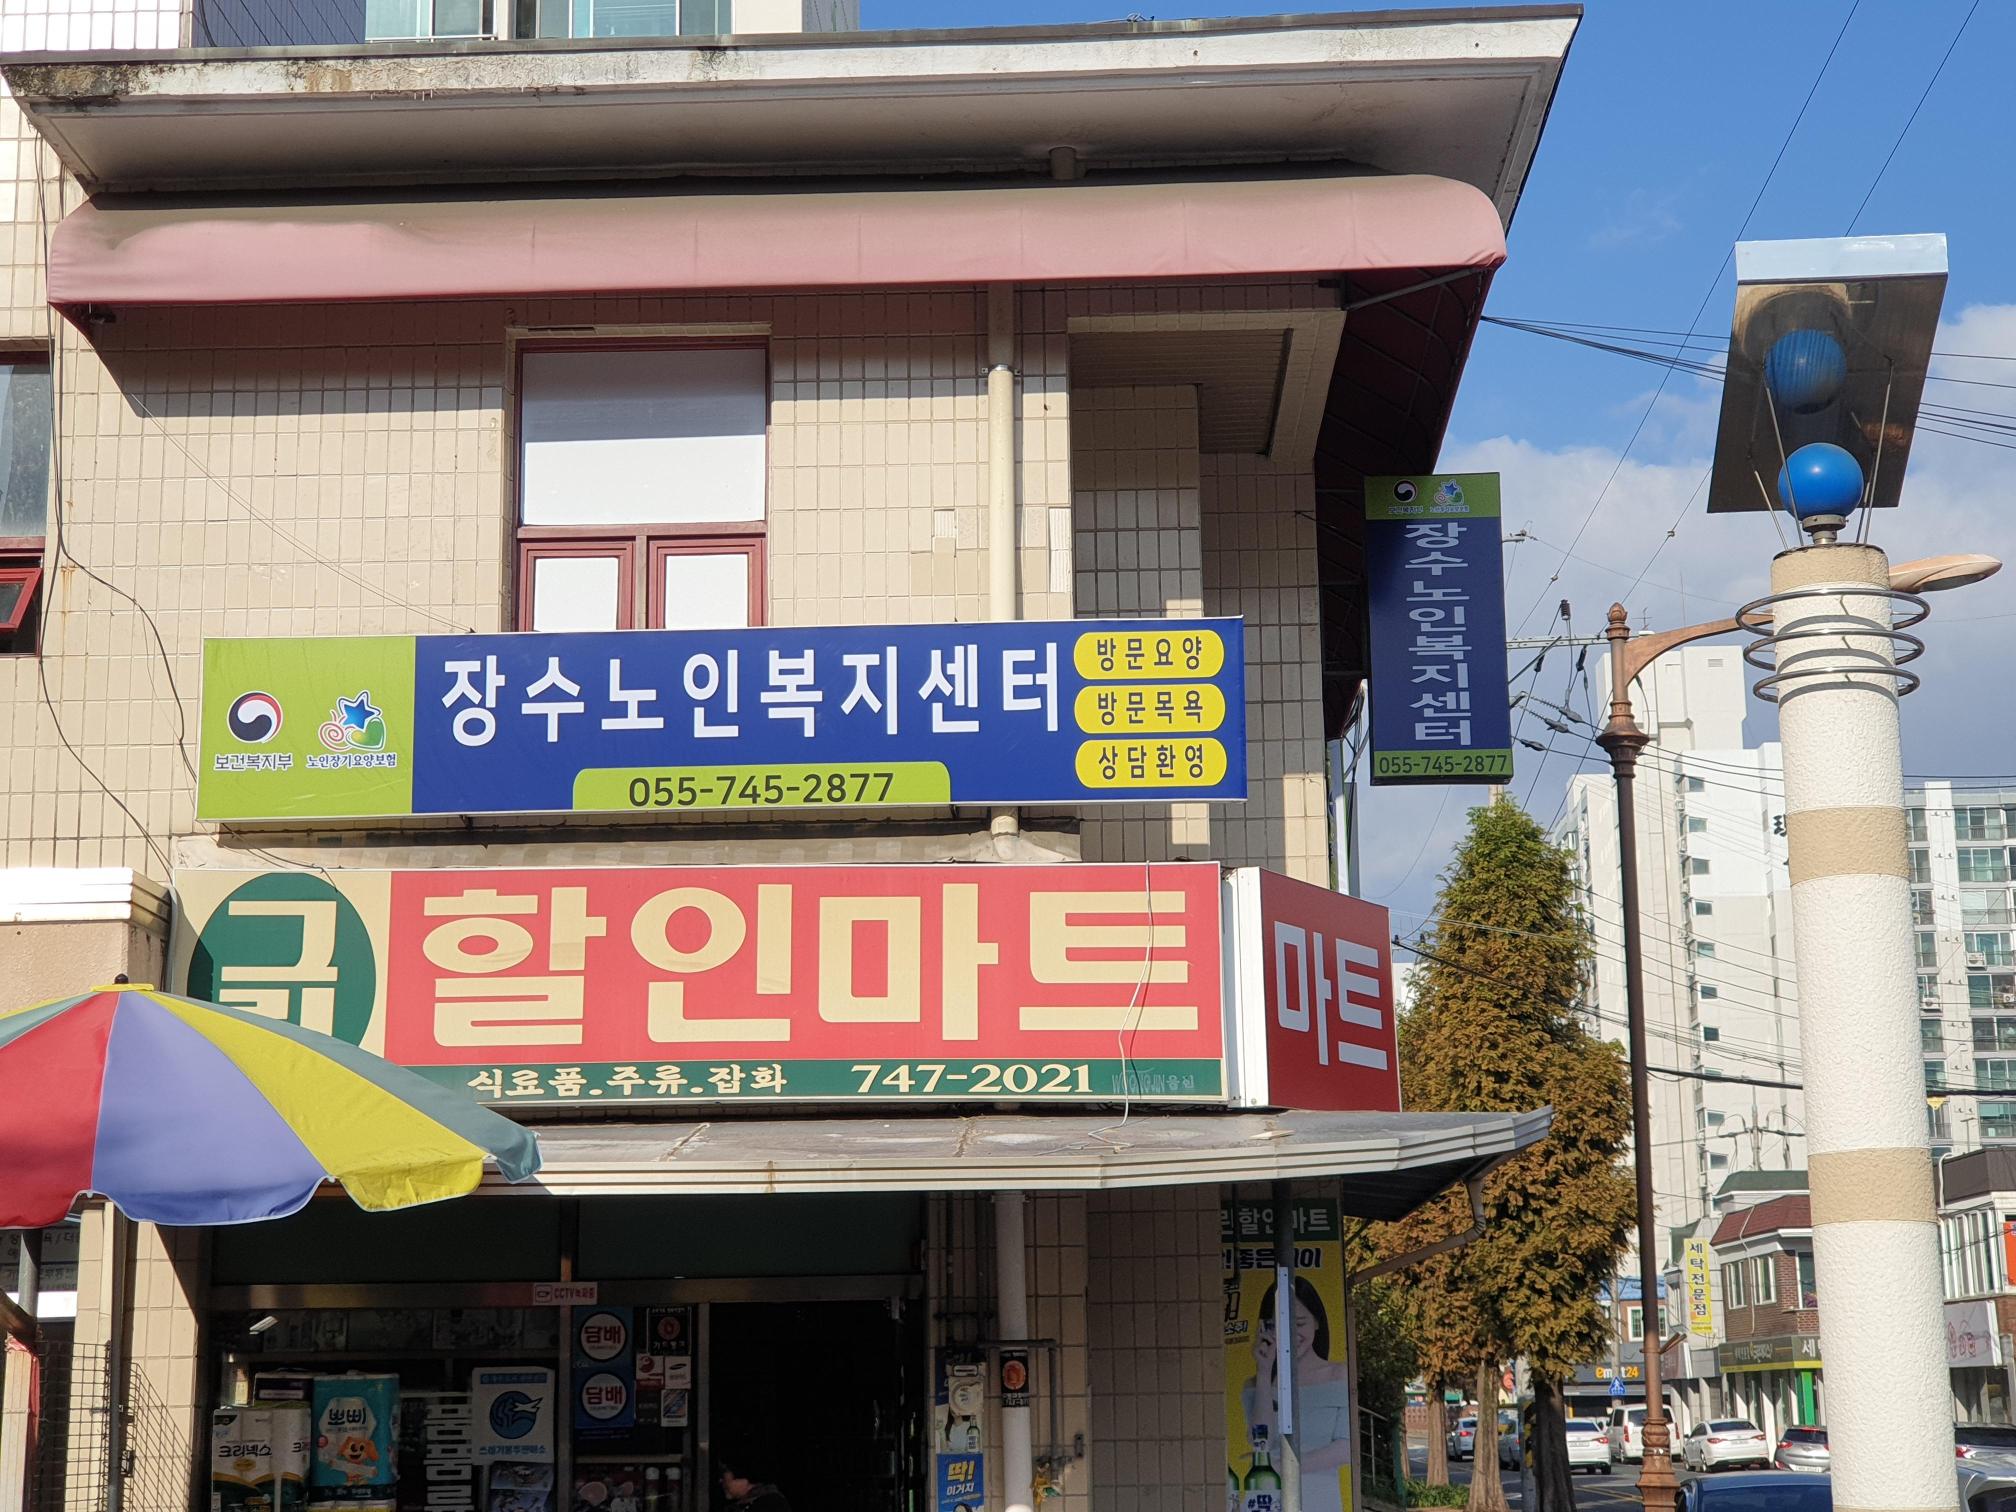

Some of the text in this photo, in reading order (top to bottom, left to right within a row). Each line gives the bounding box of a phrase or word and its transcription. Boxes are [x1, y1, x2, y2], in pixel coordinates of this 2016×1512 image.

[1403, 521, 1473, 746] 장수노인복지센터
[1096, 635, 1203, 673] 방문요양
[442, 641, 1059, 748] 장수노인복지센터
[1097, 689, 1204, 725] 방문목욕
[214, 752, 294, 772] 보건복지부
[305, 751, 398, 769] 노인장기요양보험
[1098, 742, 1205, 781] 상담환영
[1379, 754, 1508, 775] 055-745-2877
[628, 770, 895, 808] 055-745-2877
[421, 882, 1199, 1047] 할인마트
[1273, 919, 1388, 1071] 마트
[850, 1063, 1094, 1095] 747-2021
[1688, 1241, 1708, 1317] 세탁전문점
[584, 1325, 622, 1344] 담배
[1595, 1366, 1639, 1379] emt24
[585, 1385, 623, 1405] 담배
[327, 1407, 368, 1426] 뽀삐
